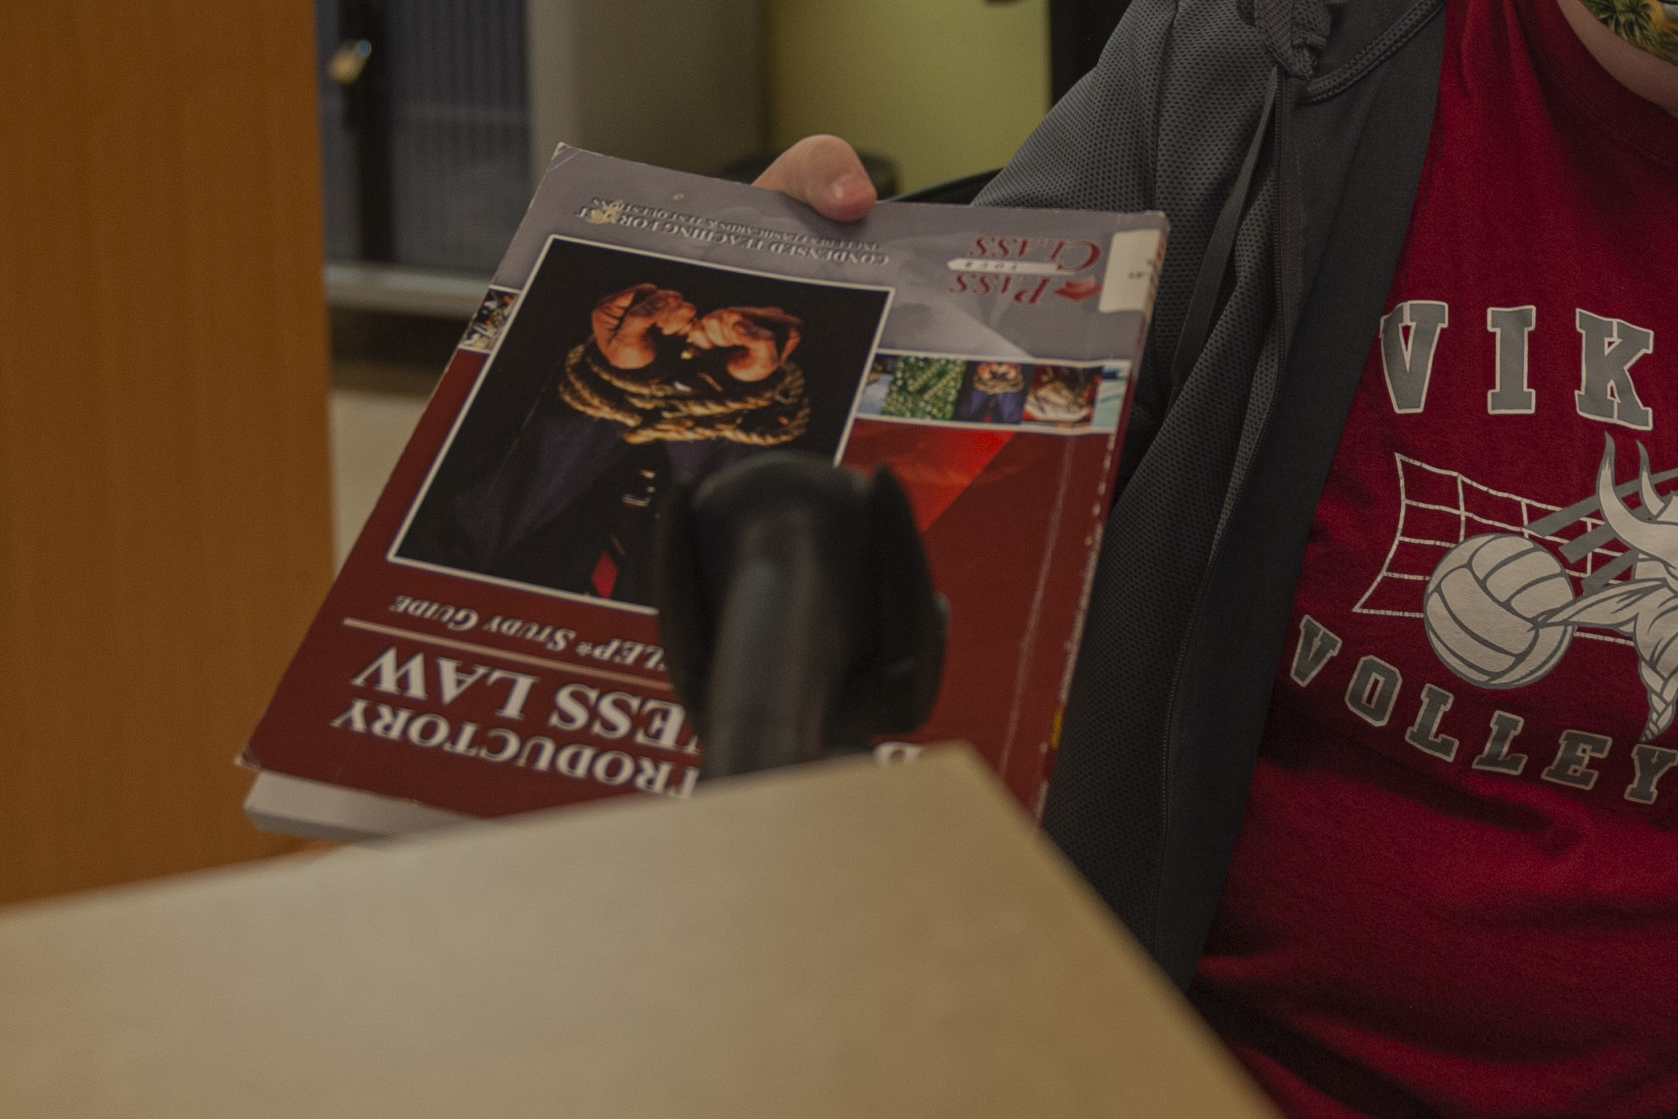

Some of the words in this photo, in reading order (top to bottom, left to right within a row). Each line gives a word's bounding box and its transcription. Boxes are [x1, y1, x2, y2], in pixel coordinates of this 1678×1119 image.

[575, 205, 659, 232] FORT
[670, 212, 702, 227] TEST
[663, 221, 764, 252] TEACHING
[770, 241, 890, 267] CONDENSED
[389, 594, 479, 632] GUIDE
[485, 615, 577, 653] STUDY
[351, 645, 541, 721] LAW
